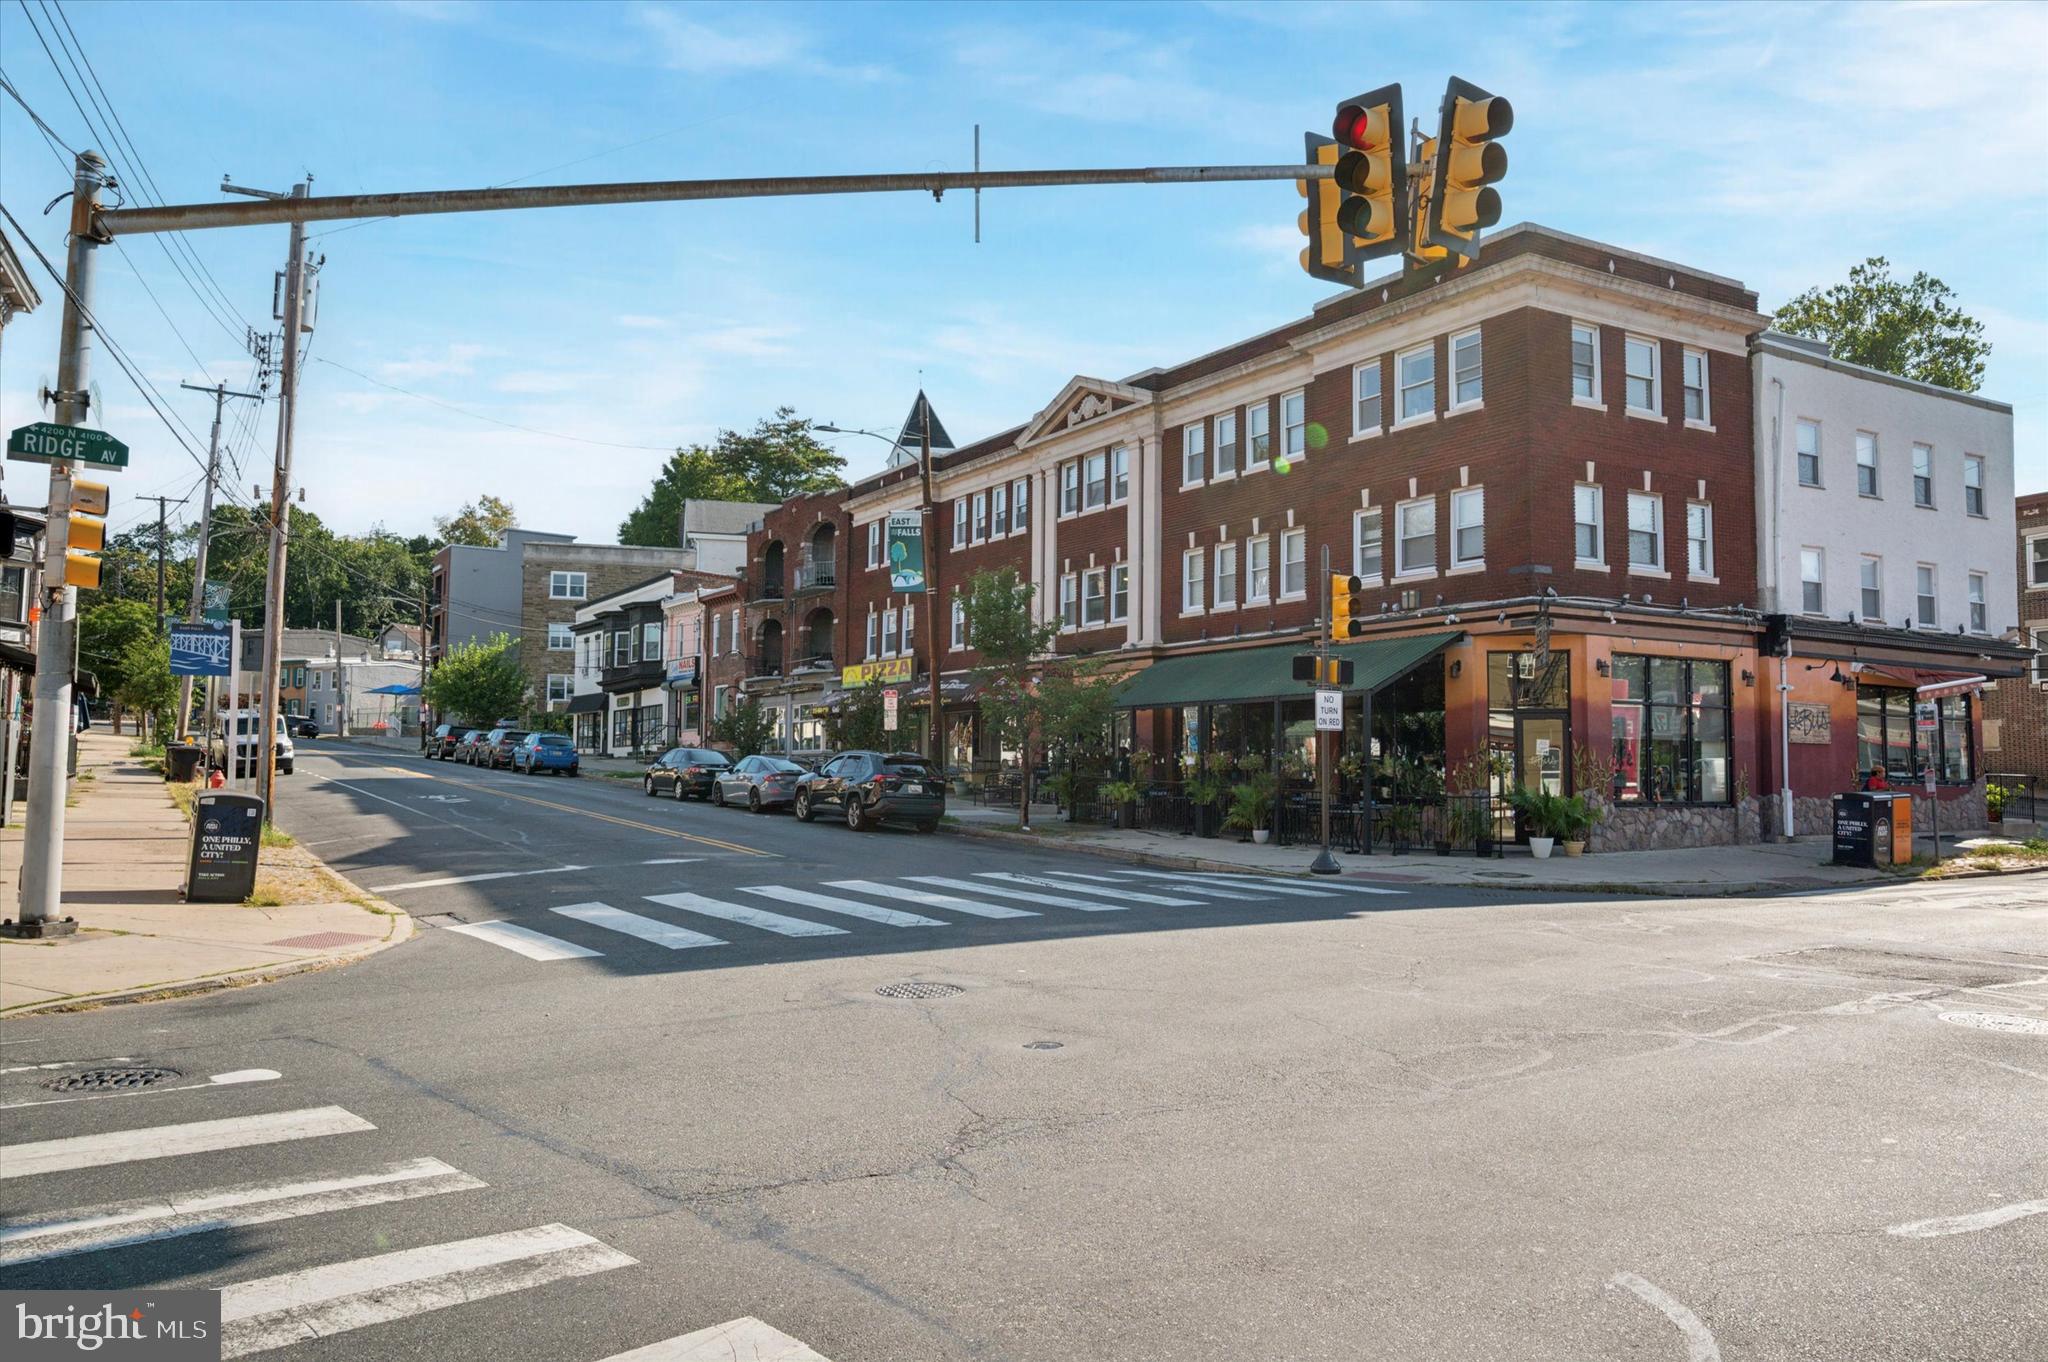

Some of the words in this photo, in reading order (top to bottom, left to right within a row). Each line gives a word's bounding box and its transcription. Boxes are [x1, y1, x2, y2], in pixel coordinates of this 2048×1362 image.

[41, 426, 64, 435] 4200
[68, 429, 76, 438] N
[80, 432, 102, 441] 4100
[24, 433, 86, 459] RIDGE
[100, 450, 117, 462] AV
[891, 517, 911, 526] EAST
[897, 528, 921, 537] FALLS
[678, 657, 696, 670] NAILS
[861, 660, 911, 680] PIZZA
[1323, 695, 1335, 704] NO
[1321, 706, 1339, 715] TURN
[1318, 717, 1328, 726] ON
[1328, 717, 1341, 726] RED
[202, 835, 221, 843] ONE
[221, 836, 252, 845] PHILLY,
[201, 843, 208, 851] A
[209, 844, 242, 852] UNITED
[200, 851, 224, 859] CITY!
